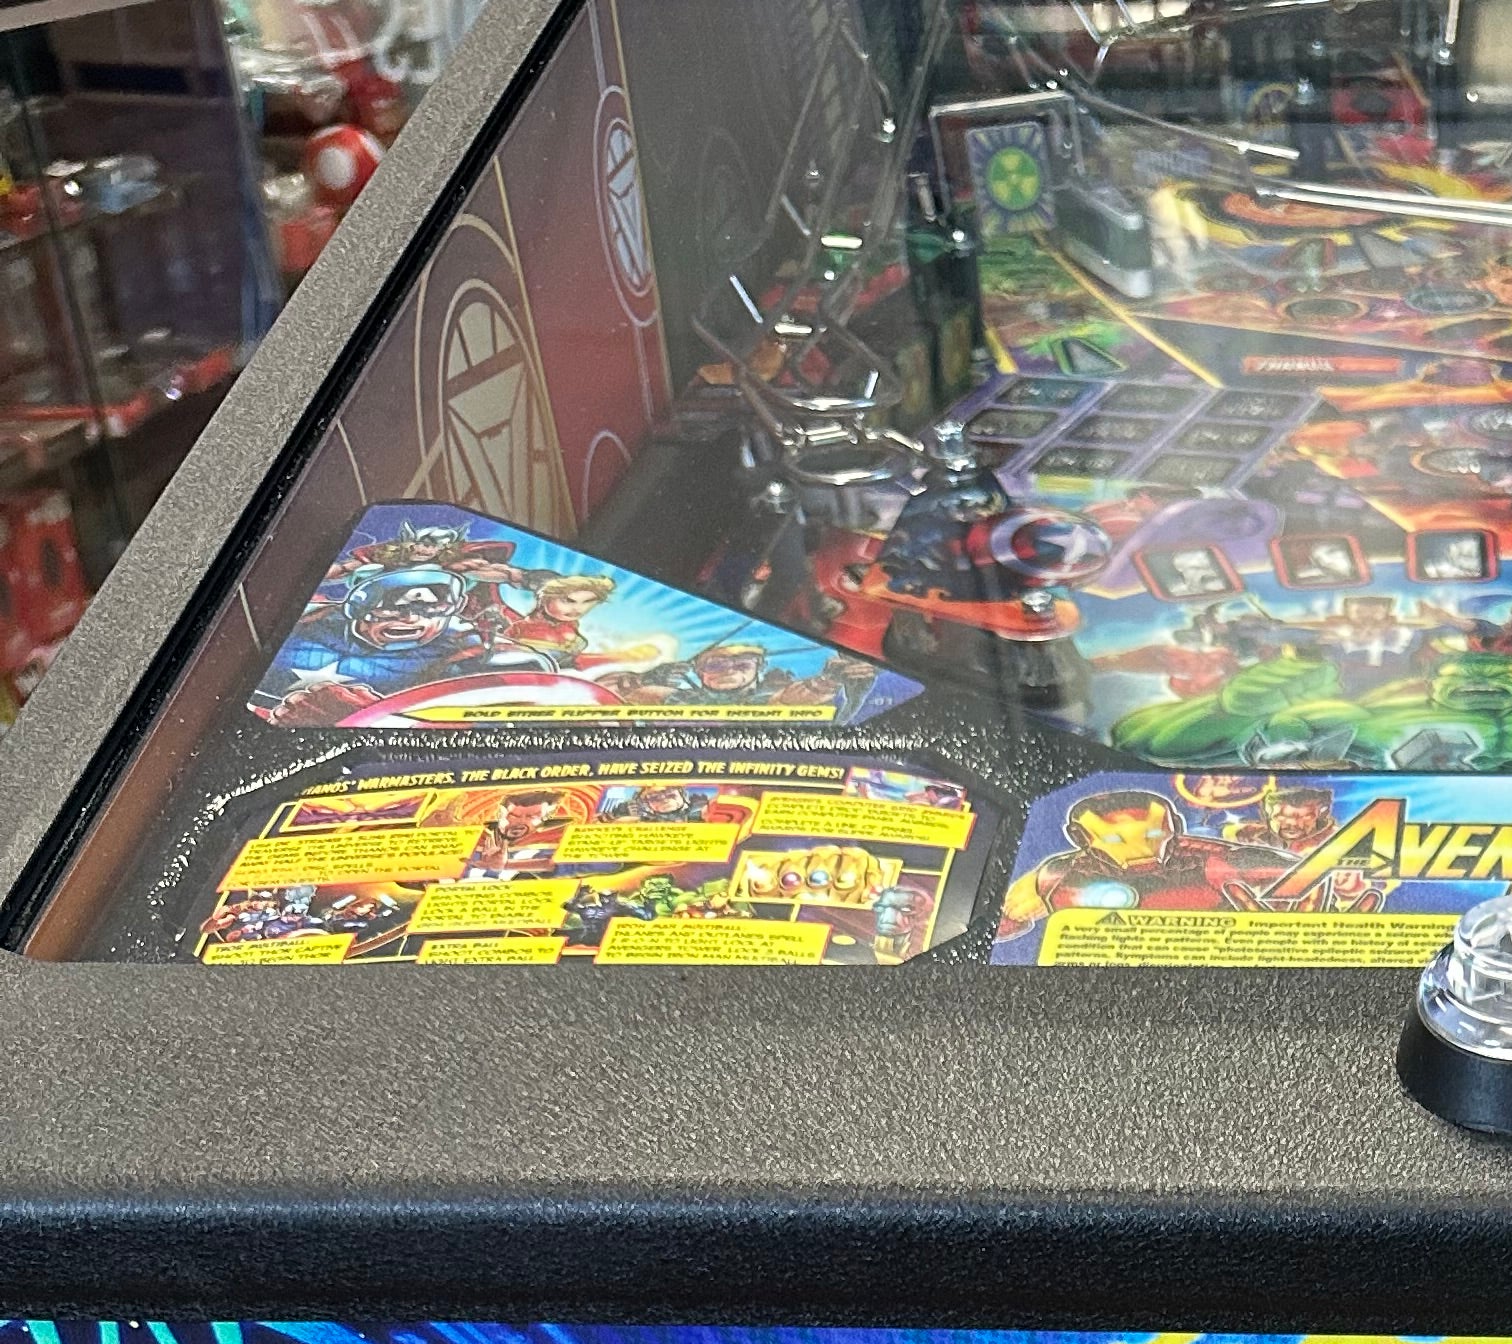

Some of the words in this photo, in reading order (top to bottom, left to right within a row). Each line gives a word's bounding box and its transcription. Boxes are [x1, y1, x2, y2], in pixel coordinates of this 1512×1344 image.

[627, 709, 684, 717] BUTTON
[690, 709, 720, 717] FOR
[460, 769, 490, 783] THE
[491, 767, 539, 781] BLACK
[540, 764, 594, 778] ORDER,
[598, 763, 638, 776] HAVE
[639, 760, 694, 775] SEIZED
[697, 761, 727, 774] THE
[728, 761, 797, 777] INFINITY
[796, 766, 845, 780] GEMS!
[1128, 914, 1236, 927] WARNING
[1249, 920, 1327, 930] Important
[1333, 921, 1385, 930] Health
[1140, 928, 1209, 936] percentage
[1060, 934, 1108, 942] flashing
[1256, 938, 1299, 946] people
[1350, 939, 1394, 947] history
[1057, 942, 1115, 950] condition
[1312, 948, 1366, 956] epileptic
[1115, 952, 1180, 960] Symptoms
[1209, 954, 1254, 962] include
